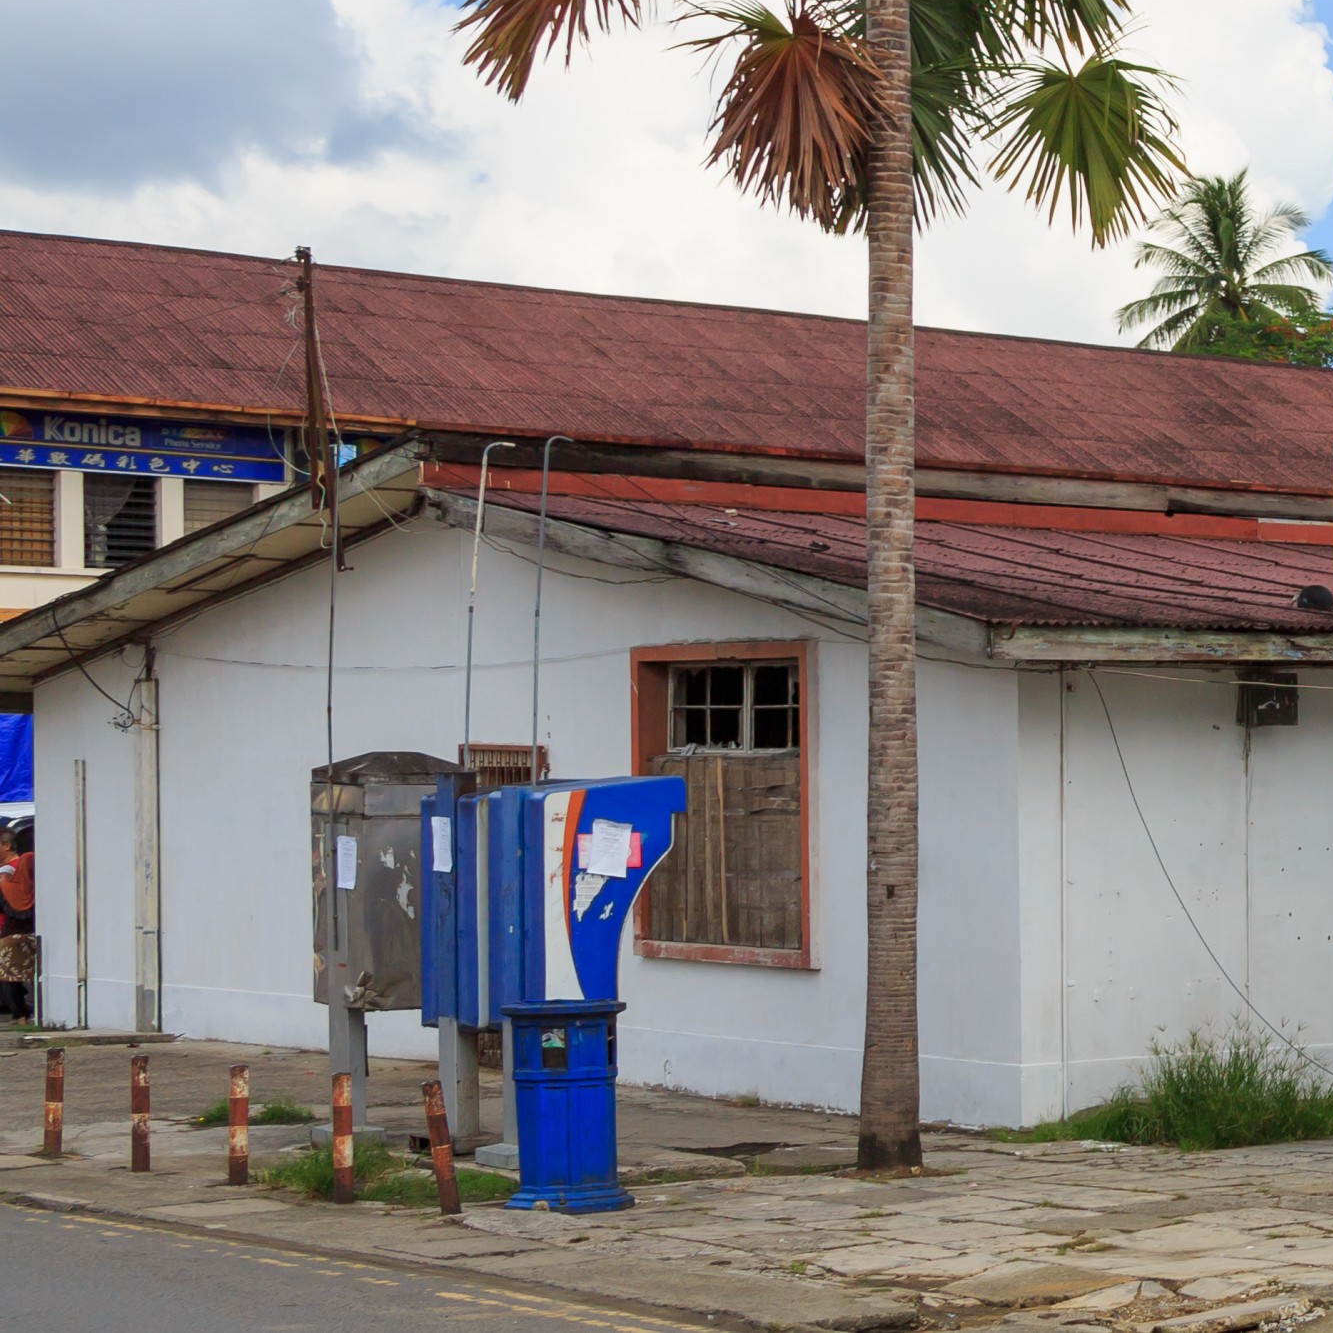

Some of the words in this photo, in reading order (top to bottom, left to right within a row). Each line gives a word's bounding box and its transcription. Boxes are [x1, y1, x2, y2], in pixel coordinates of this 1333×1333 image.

[44, 416, 141, 447] Konica
[0, 448, 234, 474] 華數碼彩色中心
